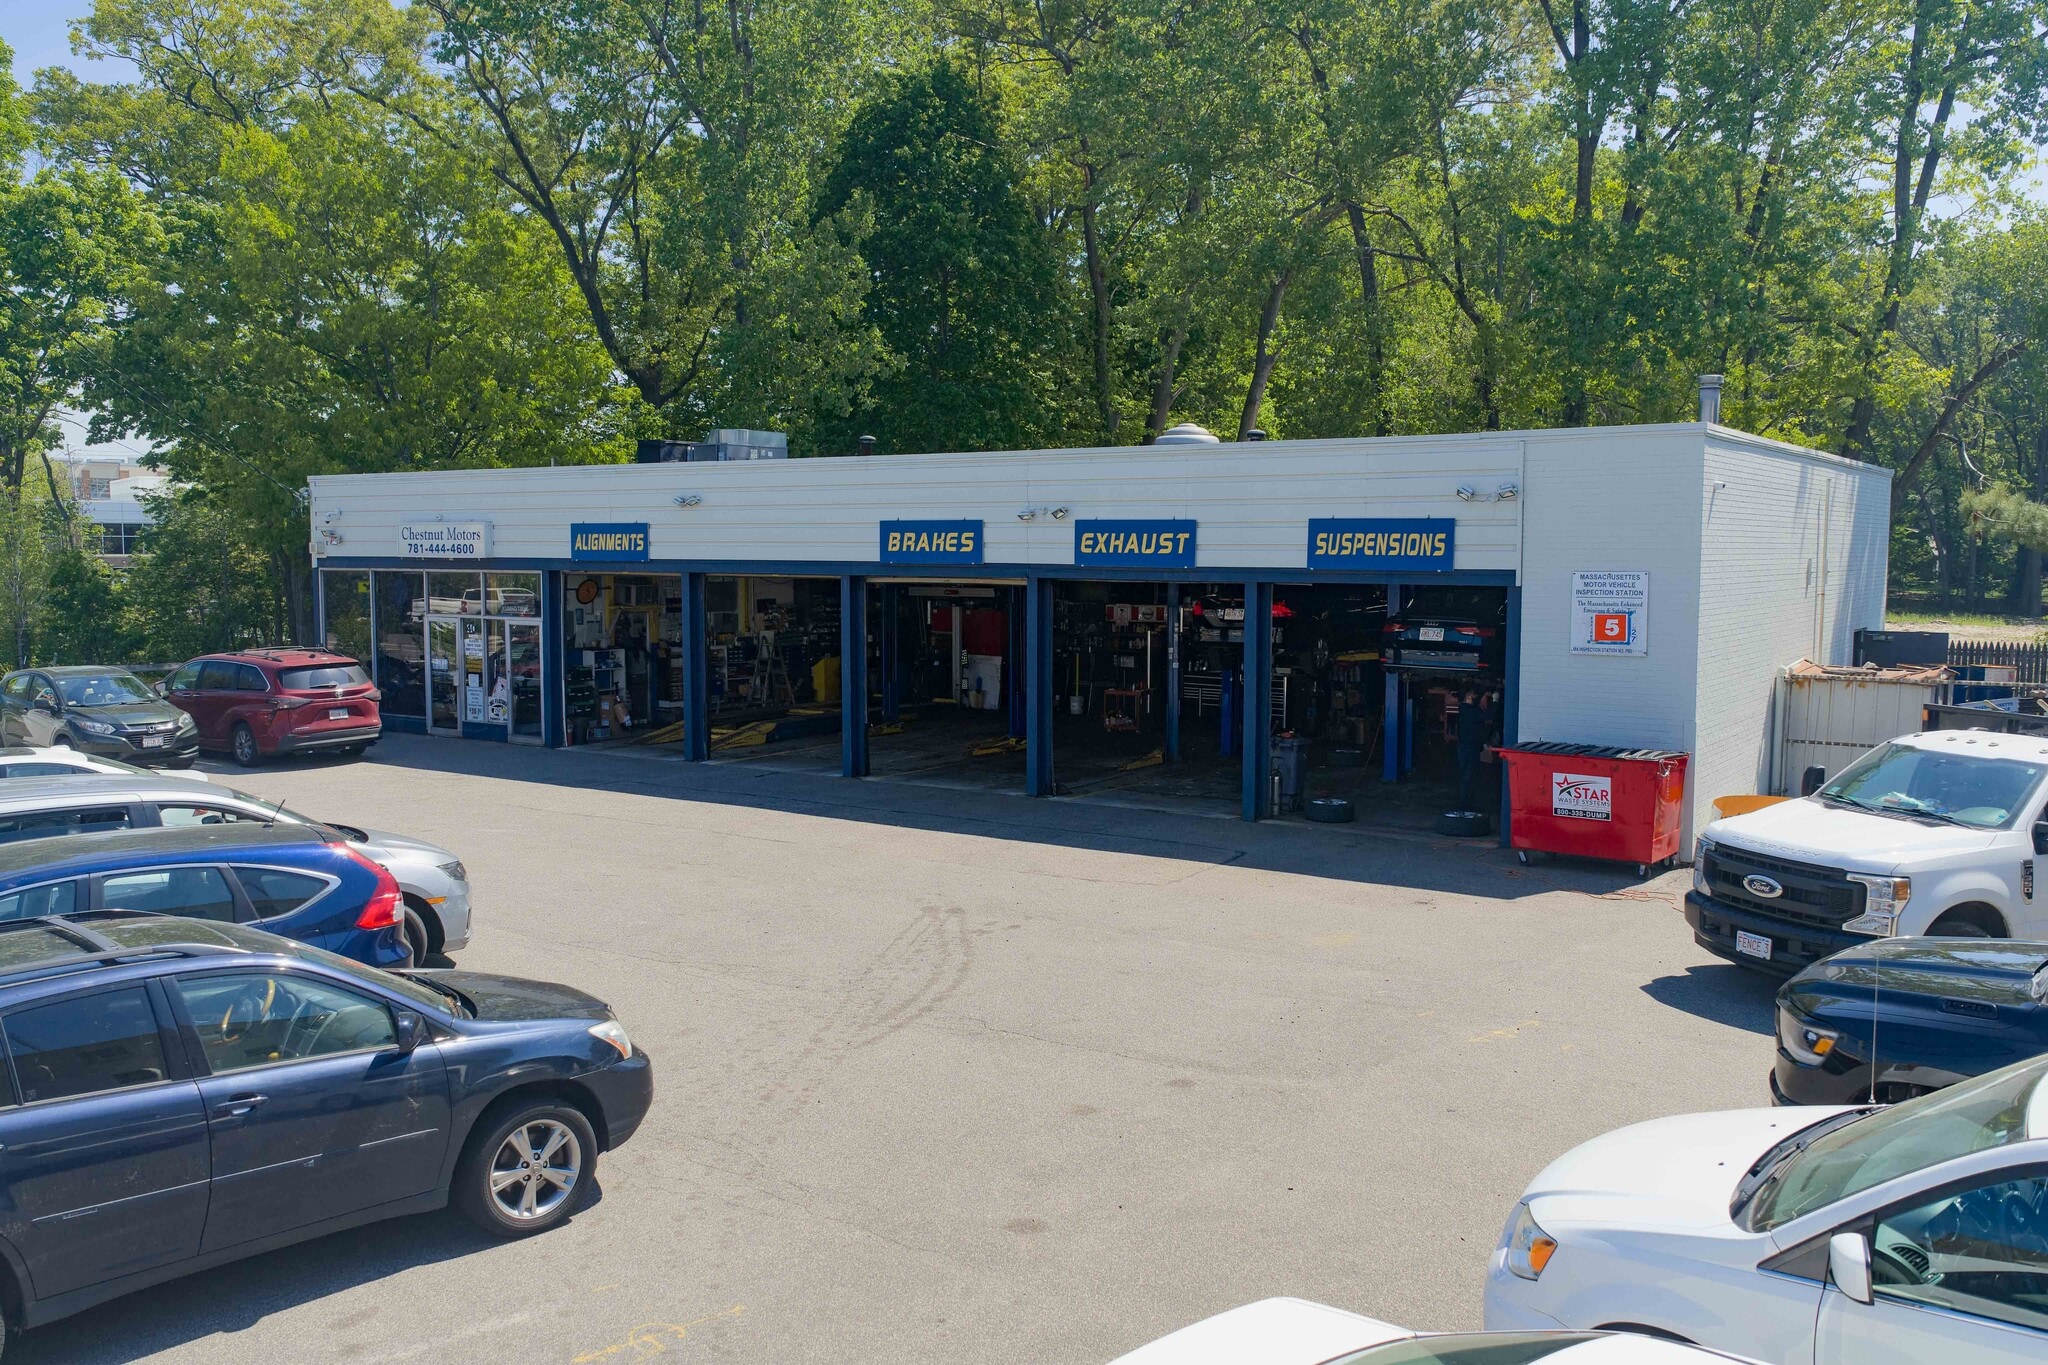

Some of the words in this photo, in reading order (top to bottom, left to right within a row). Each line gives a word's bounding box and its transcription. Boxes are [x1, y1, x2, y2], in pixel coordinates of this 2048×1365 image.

[401, 526, 444, 540] Chestnut
[446, 526, 481, 540] Motors
[574, 533, 645, 551] ALIGNMENTS
[887, 532, 975, 552] BRAKES
[407, 543, 475, 554] 781-444-4600
[1080, 532, 1190, 554] EXHAUST
[1314, 532, 1447, 557] SUSPENSIONS
[1604, 618, 1620, 636] 5
[1574, 787, 1610, 801] STAR
[1751, 881, 1771, 893] Ford
[1737, 935, 1762, 952] FENCE
[1763, 942, 1769, 954] 3
